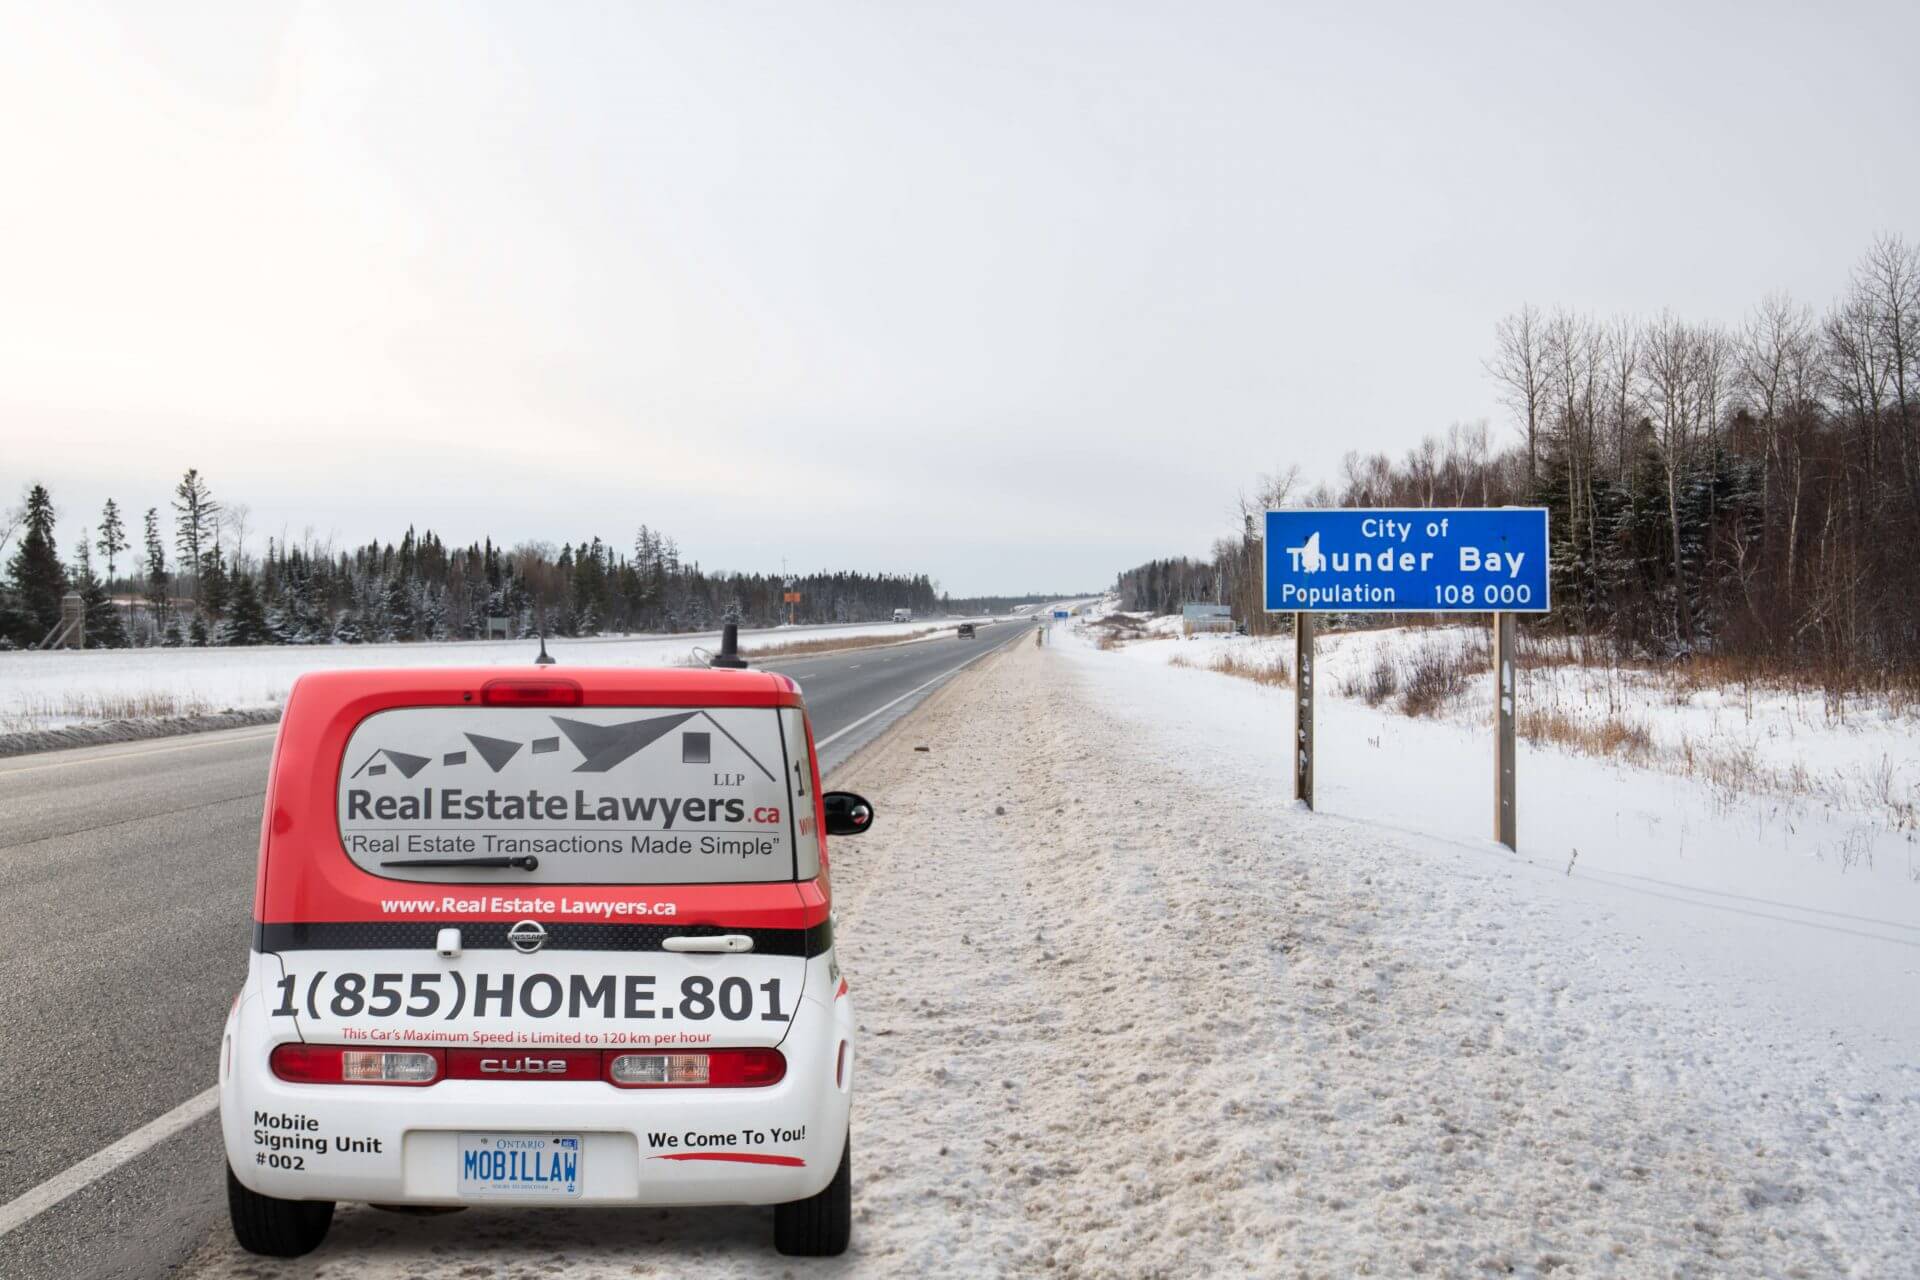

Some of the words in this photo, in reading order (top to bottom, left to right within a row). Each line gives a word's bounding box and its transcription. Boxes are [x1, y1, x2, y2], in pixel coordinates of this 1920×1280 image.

[1361, 518, 1412, 542] City
[1426, 518, 1449, 538] of
[1459, 547, 1525, 578] Bay
[1282, 584, 1396, 607] Population
[1434, 585, 1475, 604] 108
[1484, 585, 1532, 604] 000
[713, 773, 745, 786] LLP
[407, 834, 476, 853] Estate
[483, 835, 623, 854] Transactions
[631, 836, 692, 854] Made
[271, 972, 790, 1022] 1(855)HOME.801
[342, 1027, 368, 1040] This
[370, 1028, 401, 1041] Car’s
[403, 1029, 469, 1042] Maximum
[472, 1030, 514, 1045] Speed
[517, 1031, 528, 1043] is
[531, 1032, 581, 1043] Limited
[585, 1032, 599, 1044] to
[602, 1032, 627, 1044] 120
[630, 1032, 651, 1043] km
[654, 1033, 676, 1046] per
[680, 1032, 712, 1043] hour
[480, 1057, 567, 1074] cube
[253, 1129, 328, 1155] Signing
[335, 1136, 383, 1154] Unit
[496, 1139, 545, 1150] ONTARIO
[648, 1132, 679, 1148] We
[684, 1131, 738, 1147] Come
[742, 1129, 765, 1145] To
[771, 1125, 806, 1143] You!
[255, 1151, 306, 1171] #002
[464, 1150, 577, 1182] MOBILLAW
